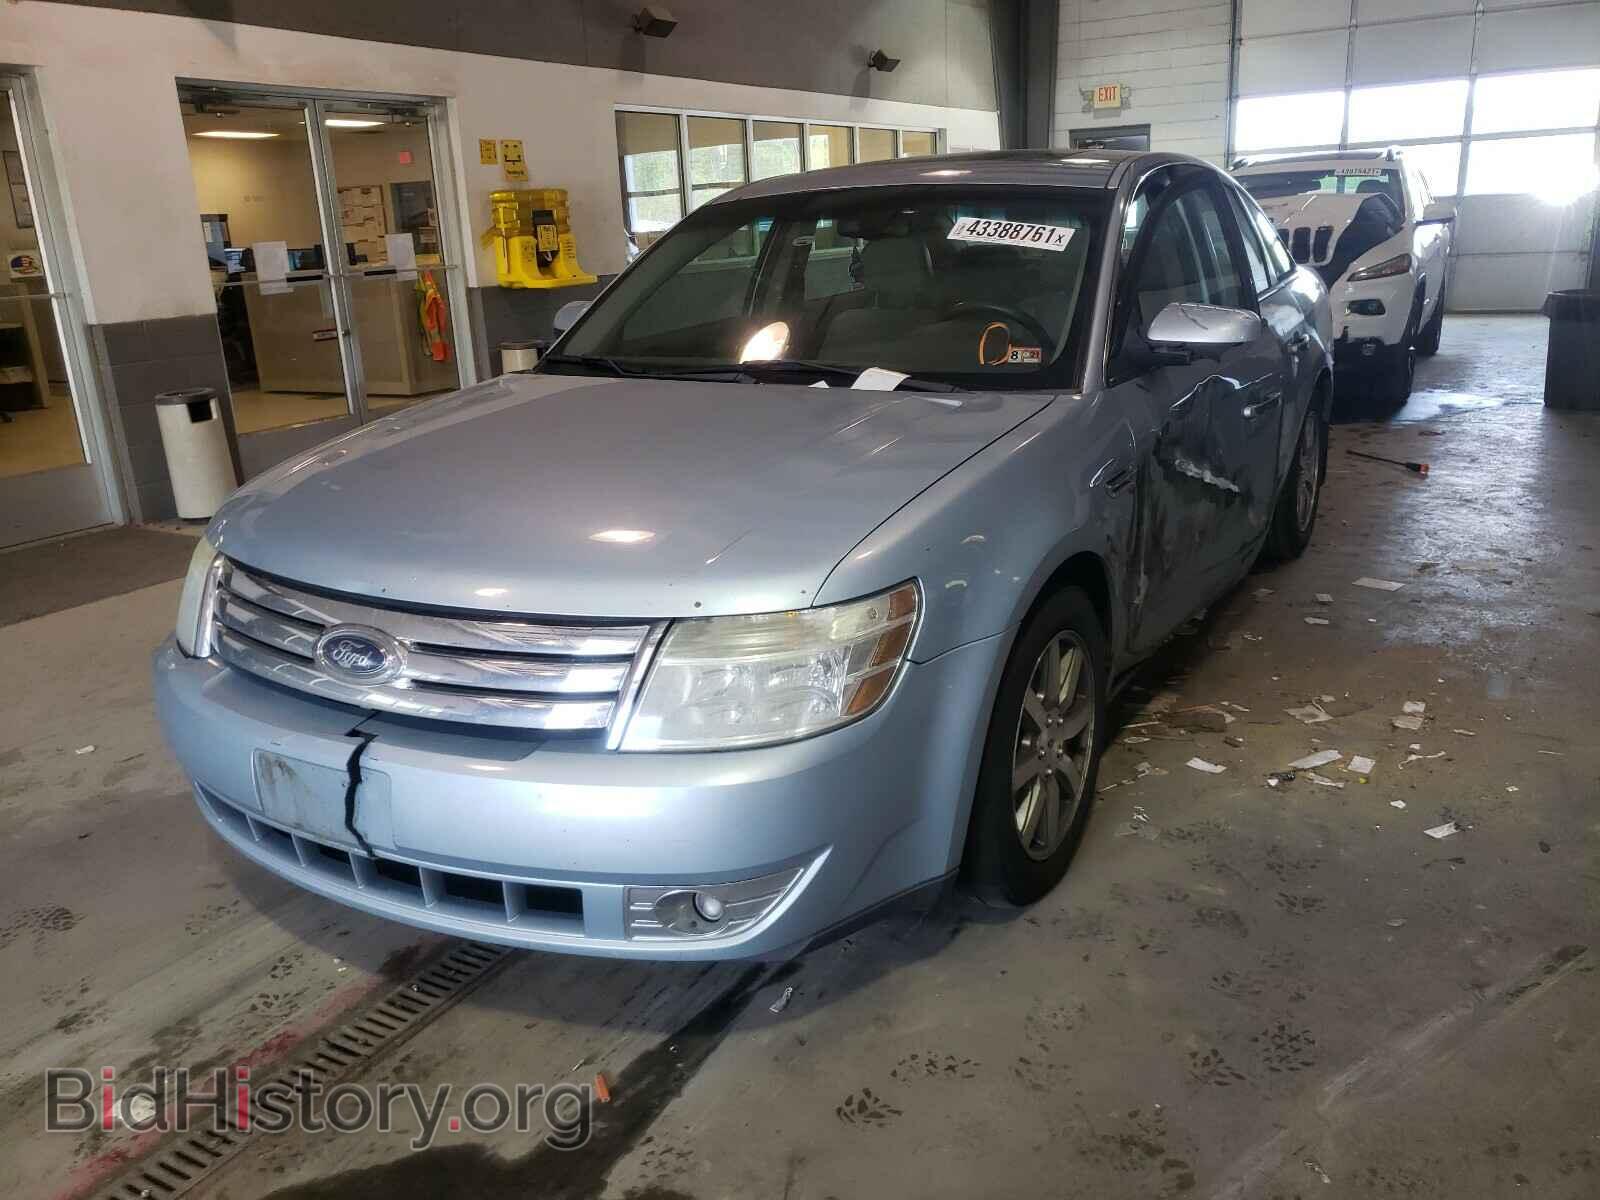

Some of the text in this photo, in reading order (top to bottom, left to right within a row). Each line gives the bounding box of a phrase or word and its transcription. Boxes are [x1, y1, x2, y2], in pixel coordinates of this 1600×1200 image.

[1098, 86, 1118, 102] EXIT
[966, 219, 1056, 243] 43388761
[1011, 350, 1019, 360] 8
[332, 640, 371, 670] Ford
